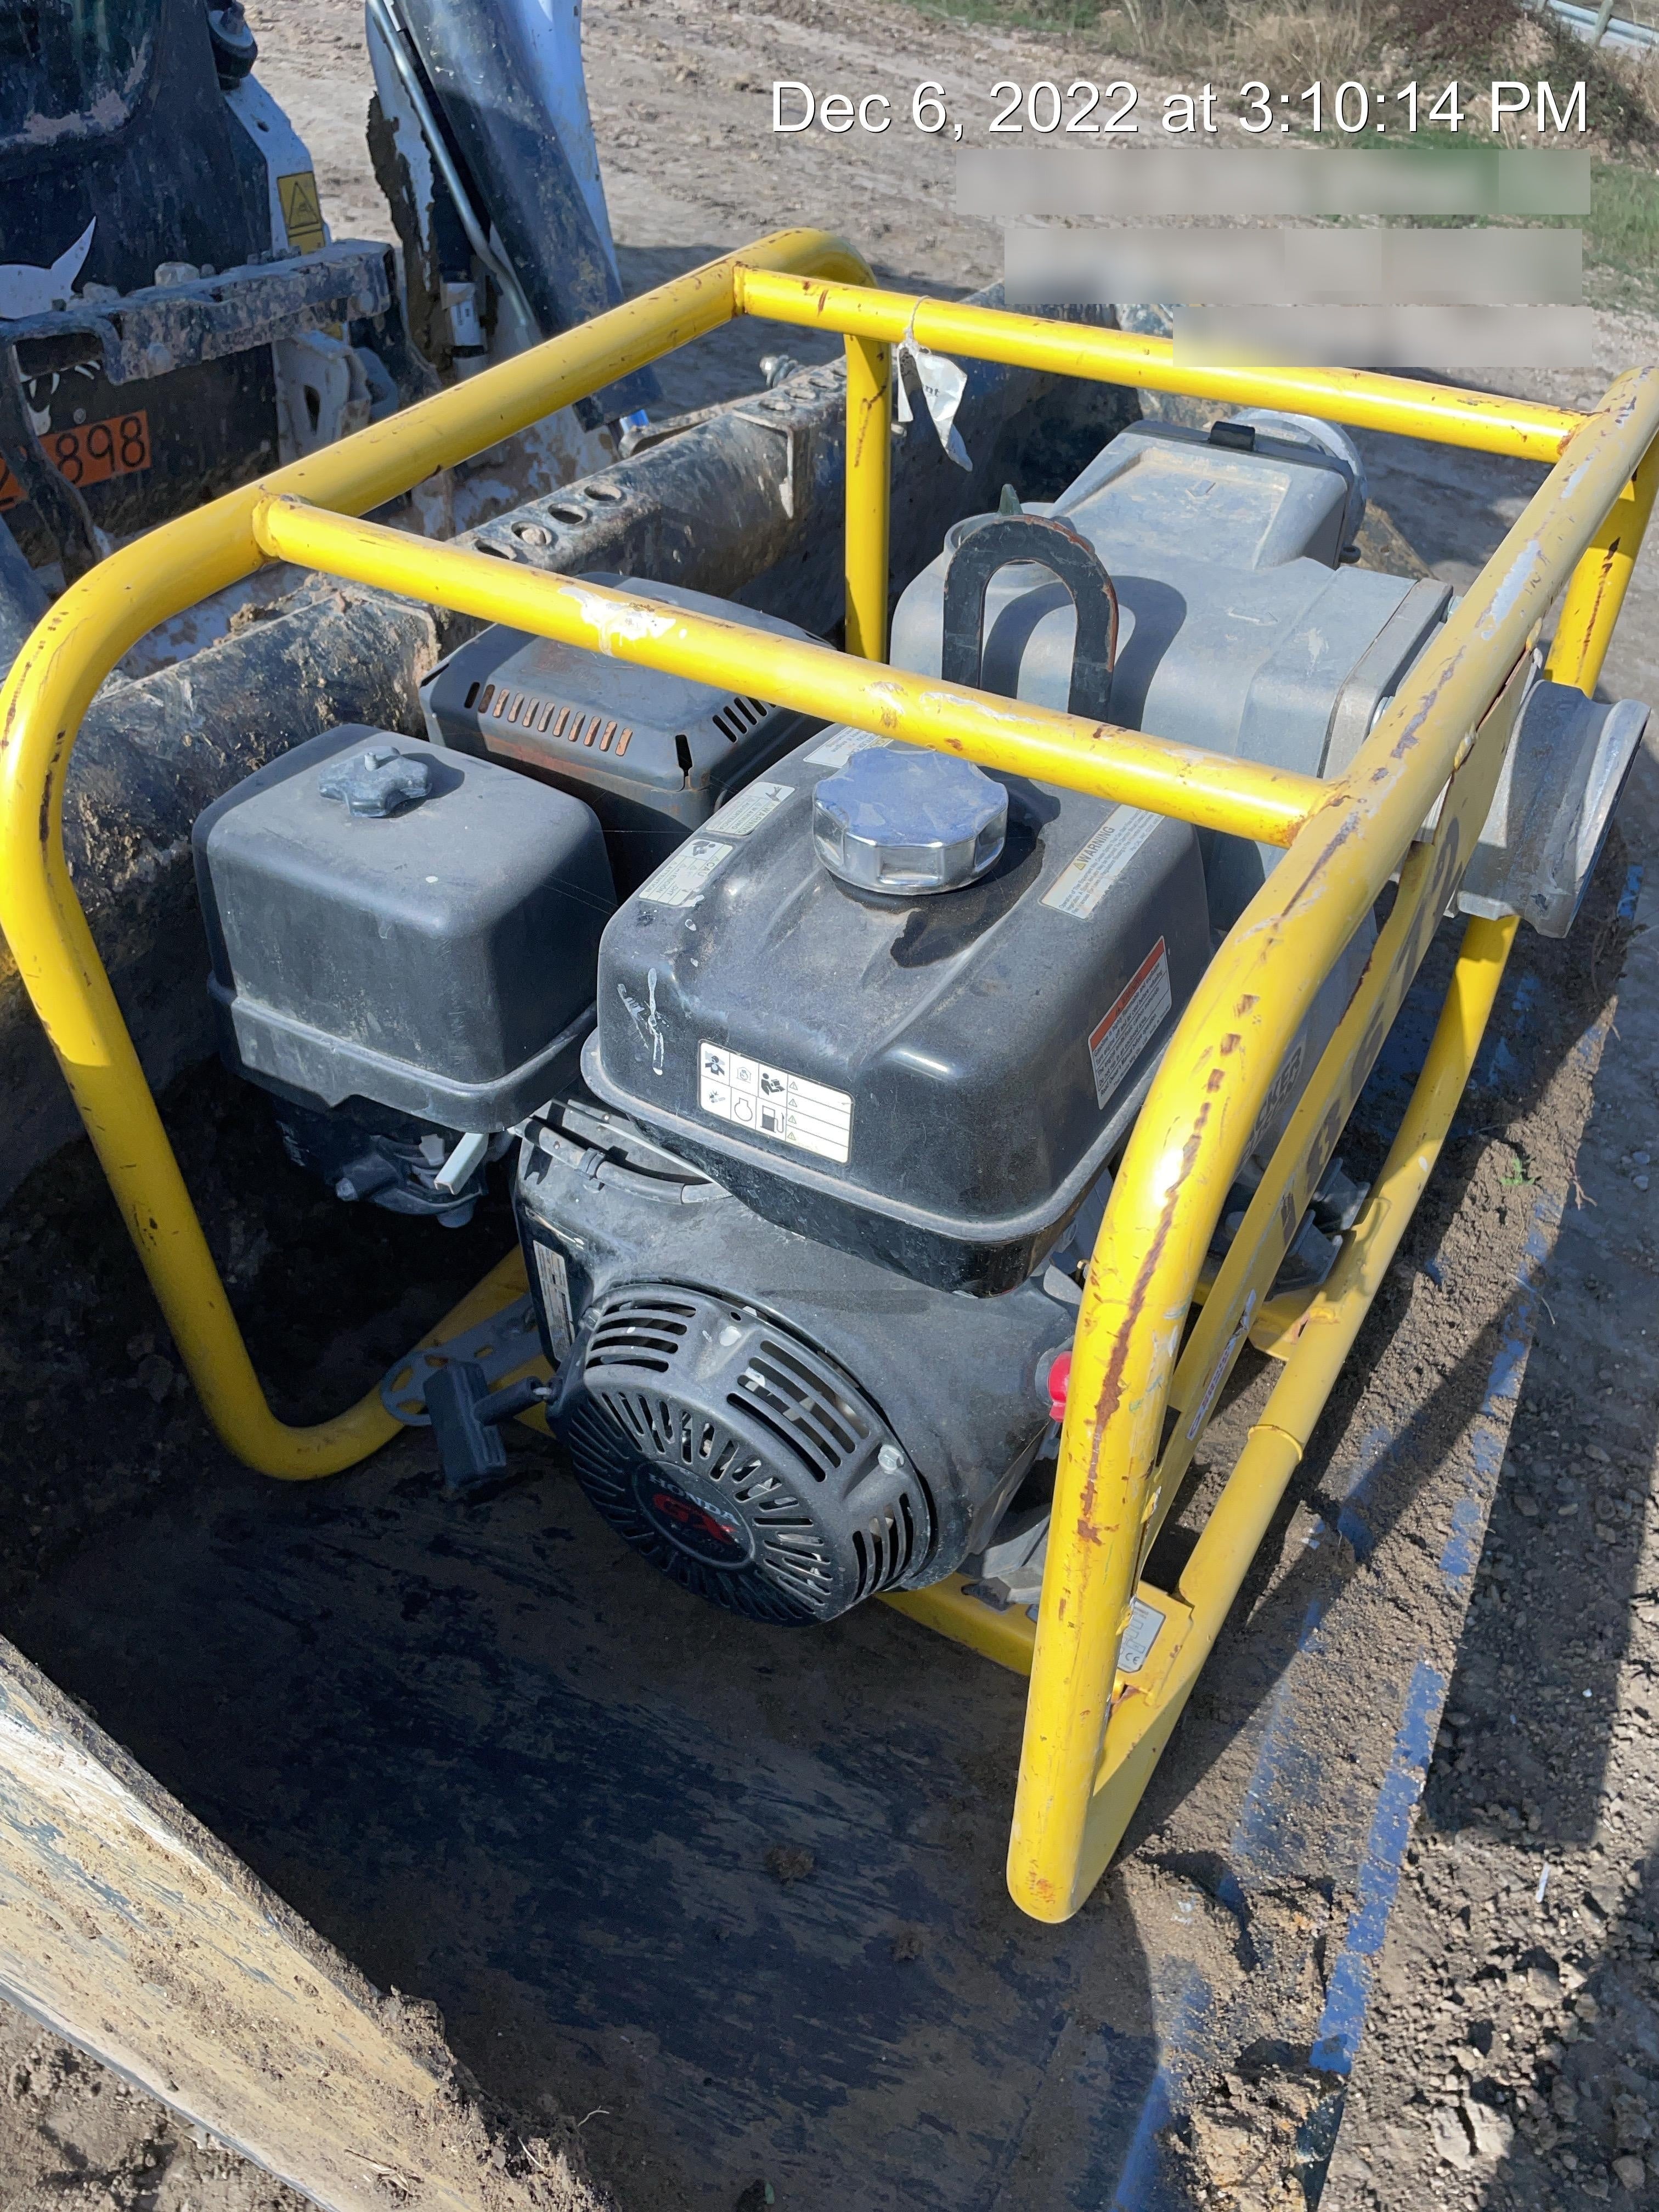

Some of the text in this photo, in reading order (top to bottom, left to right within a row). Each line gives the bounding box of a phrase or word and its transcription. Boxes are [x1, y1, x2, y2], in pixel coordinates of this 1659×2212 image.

[1076, 825, 1116, 864] WARNING
[648, 1473, 741, 1526] HONDA
[653, 1493, 738, 1545] GX
